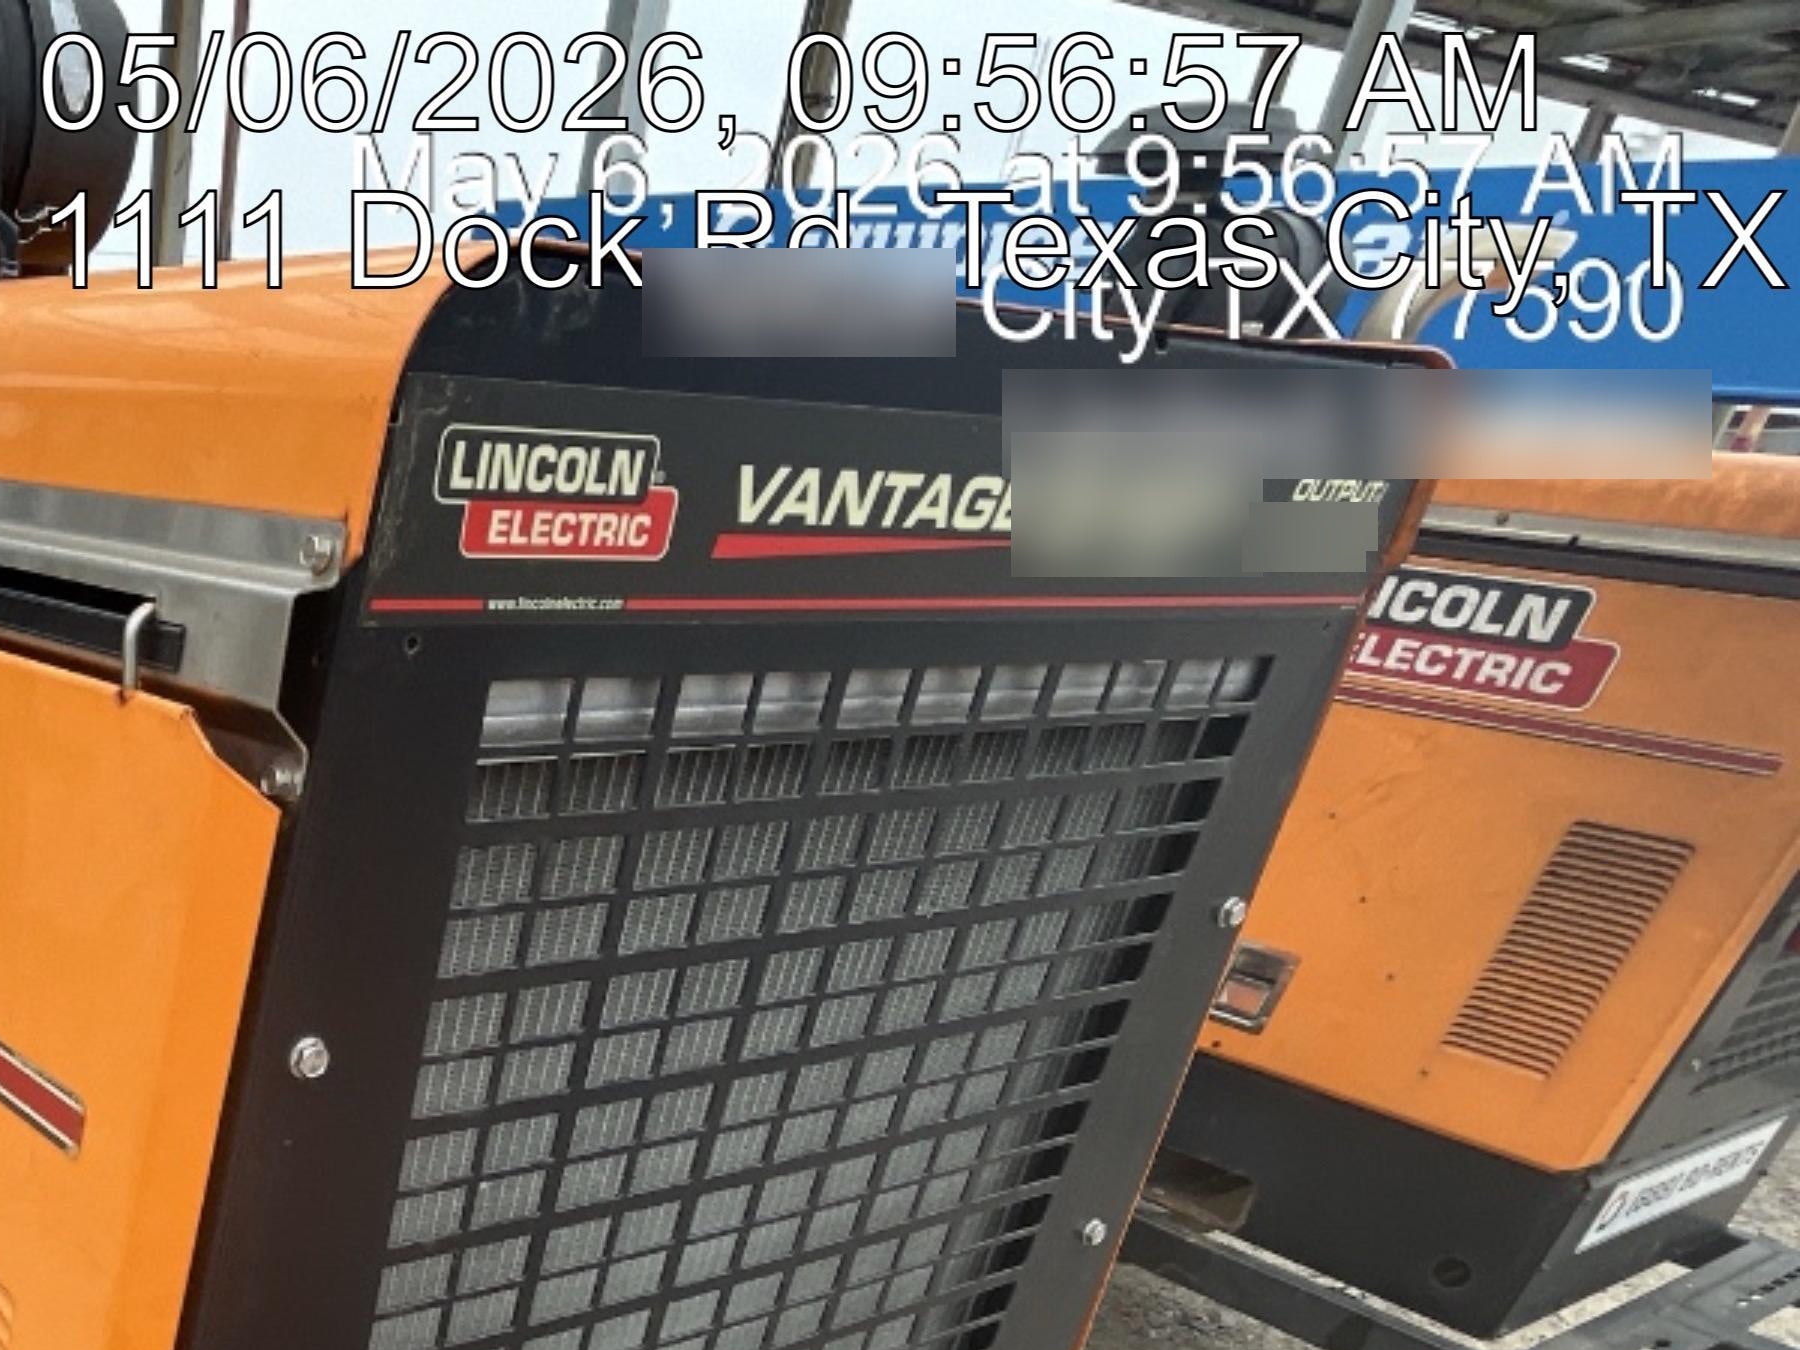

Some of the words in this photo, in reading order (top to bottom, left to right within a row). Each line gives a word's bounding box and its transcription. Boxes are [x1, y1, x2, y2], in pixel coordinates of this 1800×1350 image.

[450, 440, 646, 497] LINCOLN
[487, 509, 652, 548] ELECTRIC
[1350, 632, 1573, 695] LECTRIC
